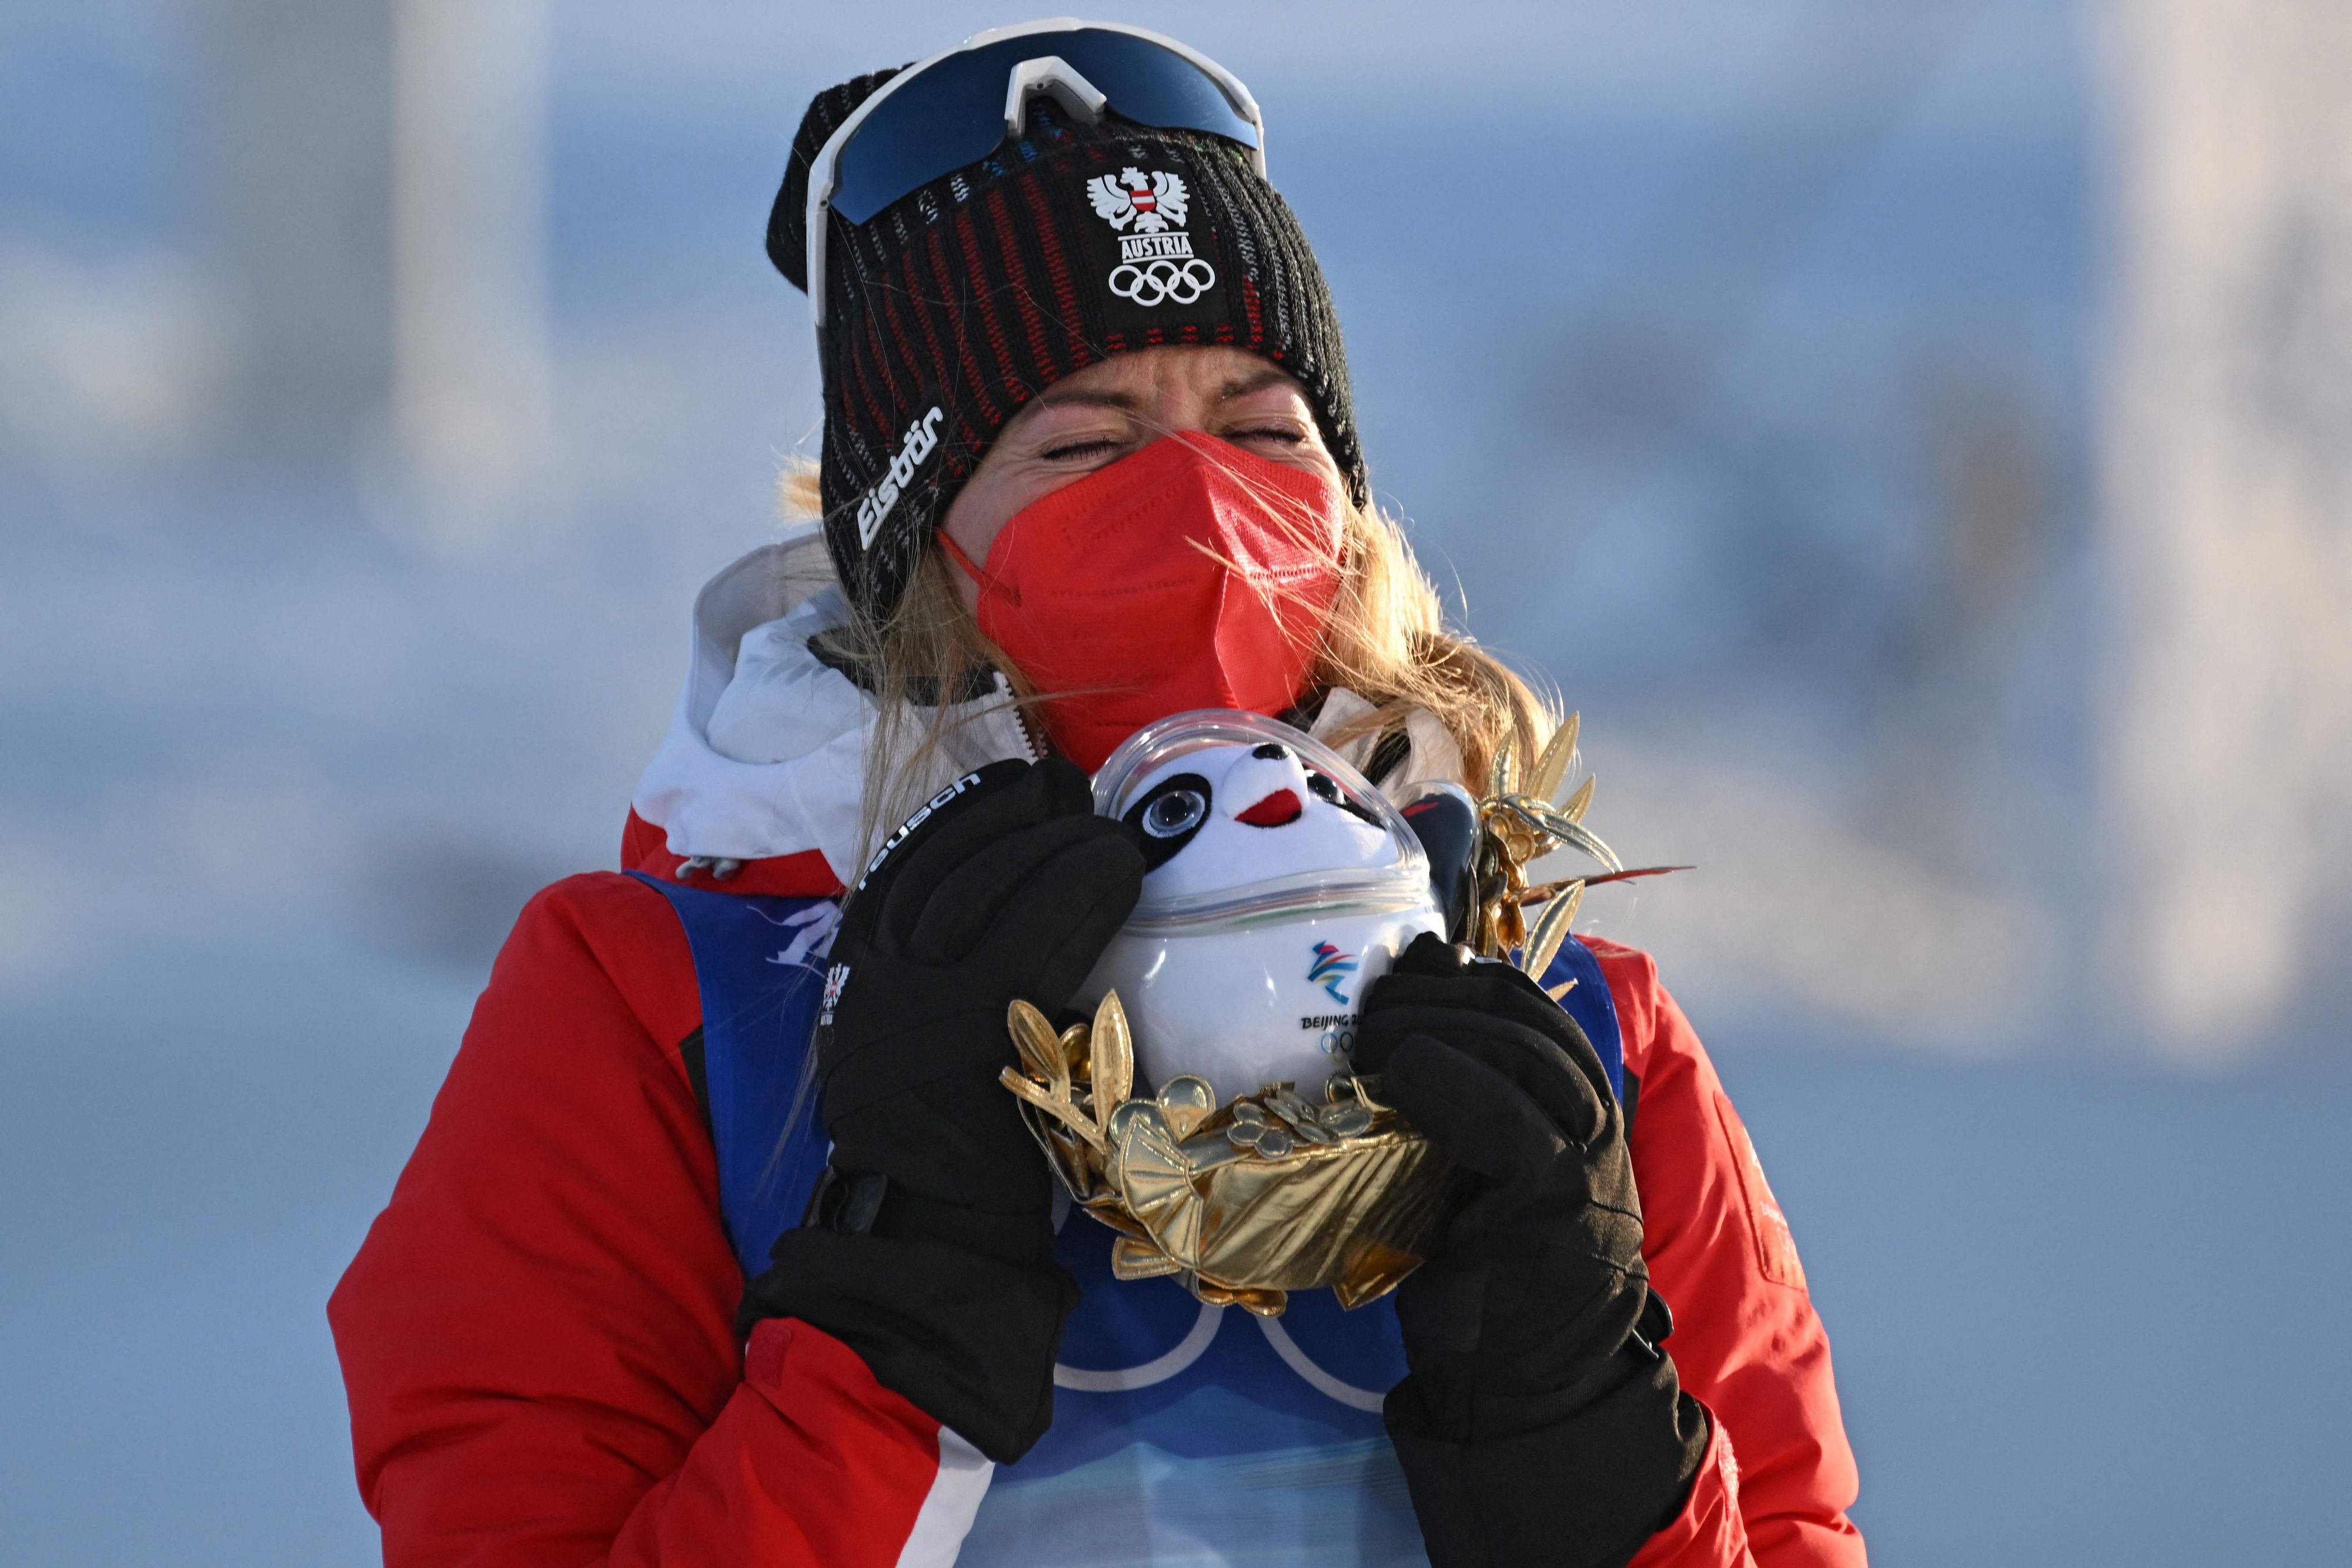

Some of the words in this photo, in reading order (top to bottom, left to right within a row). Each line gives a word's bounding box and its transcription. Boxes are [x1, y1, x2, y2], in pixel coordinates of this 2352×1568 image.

[1121, 236, 1193, 259] AUSTRIA
[857, 406, 943, 550] Eisbär
[858, 773, 981, 891] reusch
[1301, 1015, 1349, 1031] BEIJING
